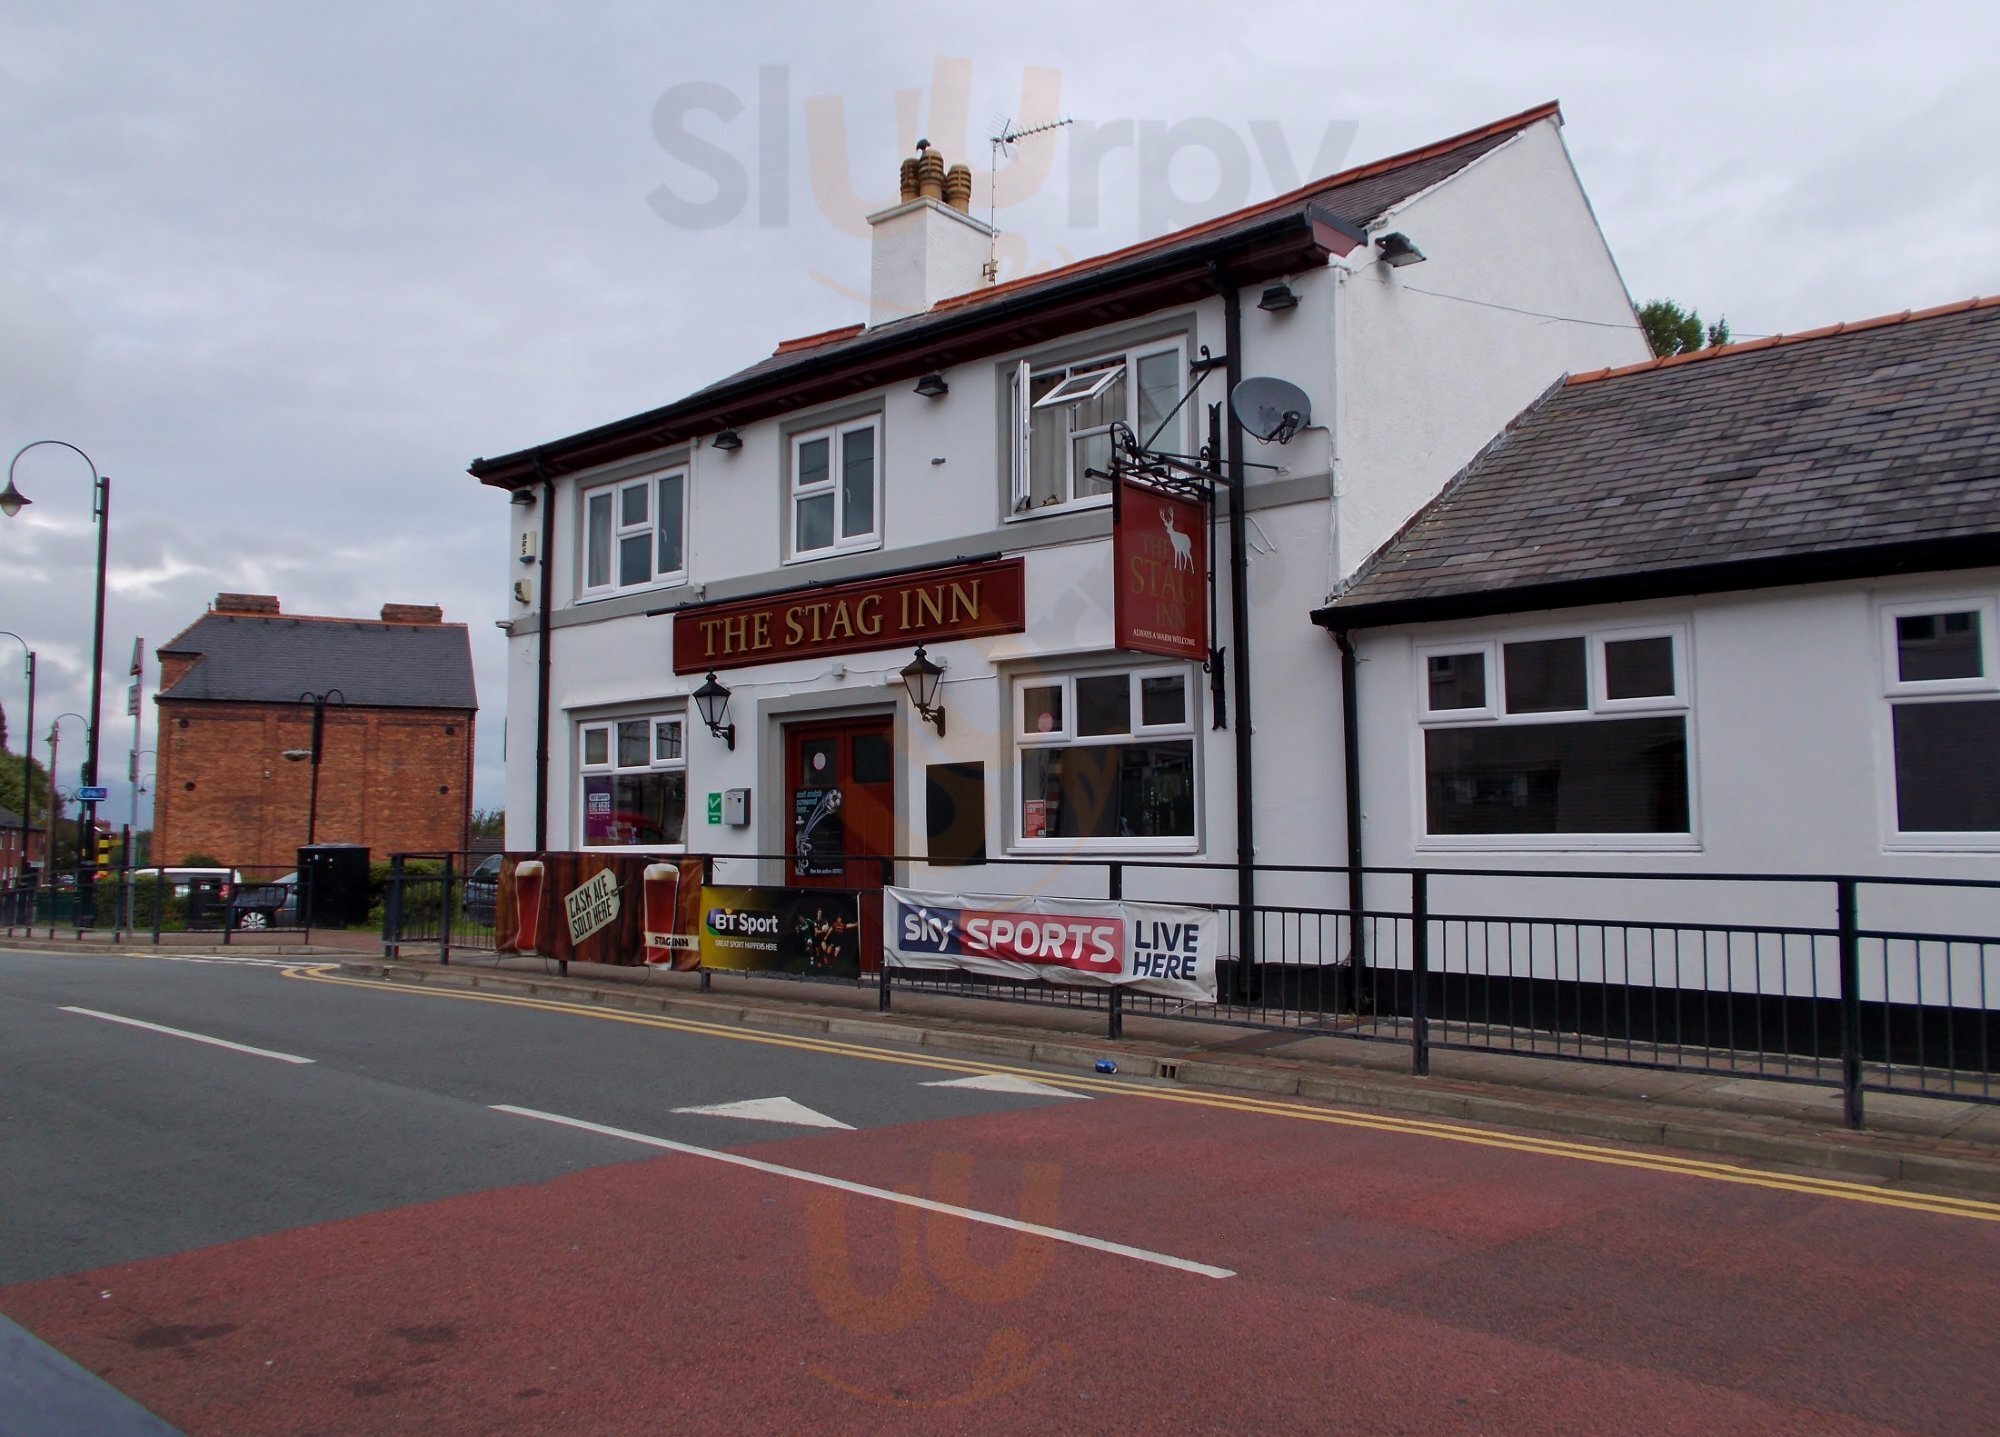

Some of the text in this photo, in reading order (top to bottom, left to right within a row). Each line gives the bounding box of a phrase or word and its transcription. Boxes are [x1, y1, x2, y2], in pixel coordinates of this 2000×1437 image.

[1139, 531, 1170, 557] THE
[1131, 555, 1196, 605] STAG
[701, 579, 981, 656] THE STAG INN
[1155, 601, 1187, 630] INN
[1172, 634, 1195, 646] WELCOME
[568, 875, 609, 918] CASK ALE
[572, 898, 612, 939] SOLD HERE
[715, 913, 778, 935] BT Sport
[654, 936, 689, 947] STAG INN
[714, 939, 778, 951] GREAT SPORT HAPPENS HERE
[967, 917, 1115, 963] SPORTS
[1135, 919, 1200, 953] LIVE
[1132, 951, 1197, 981] HERE
